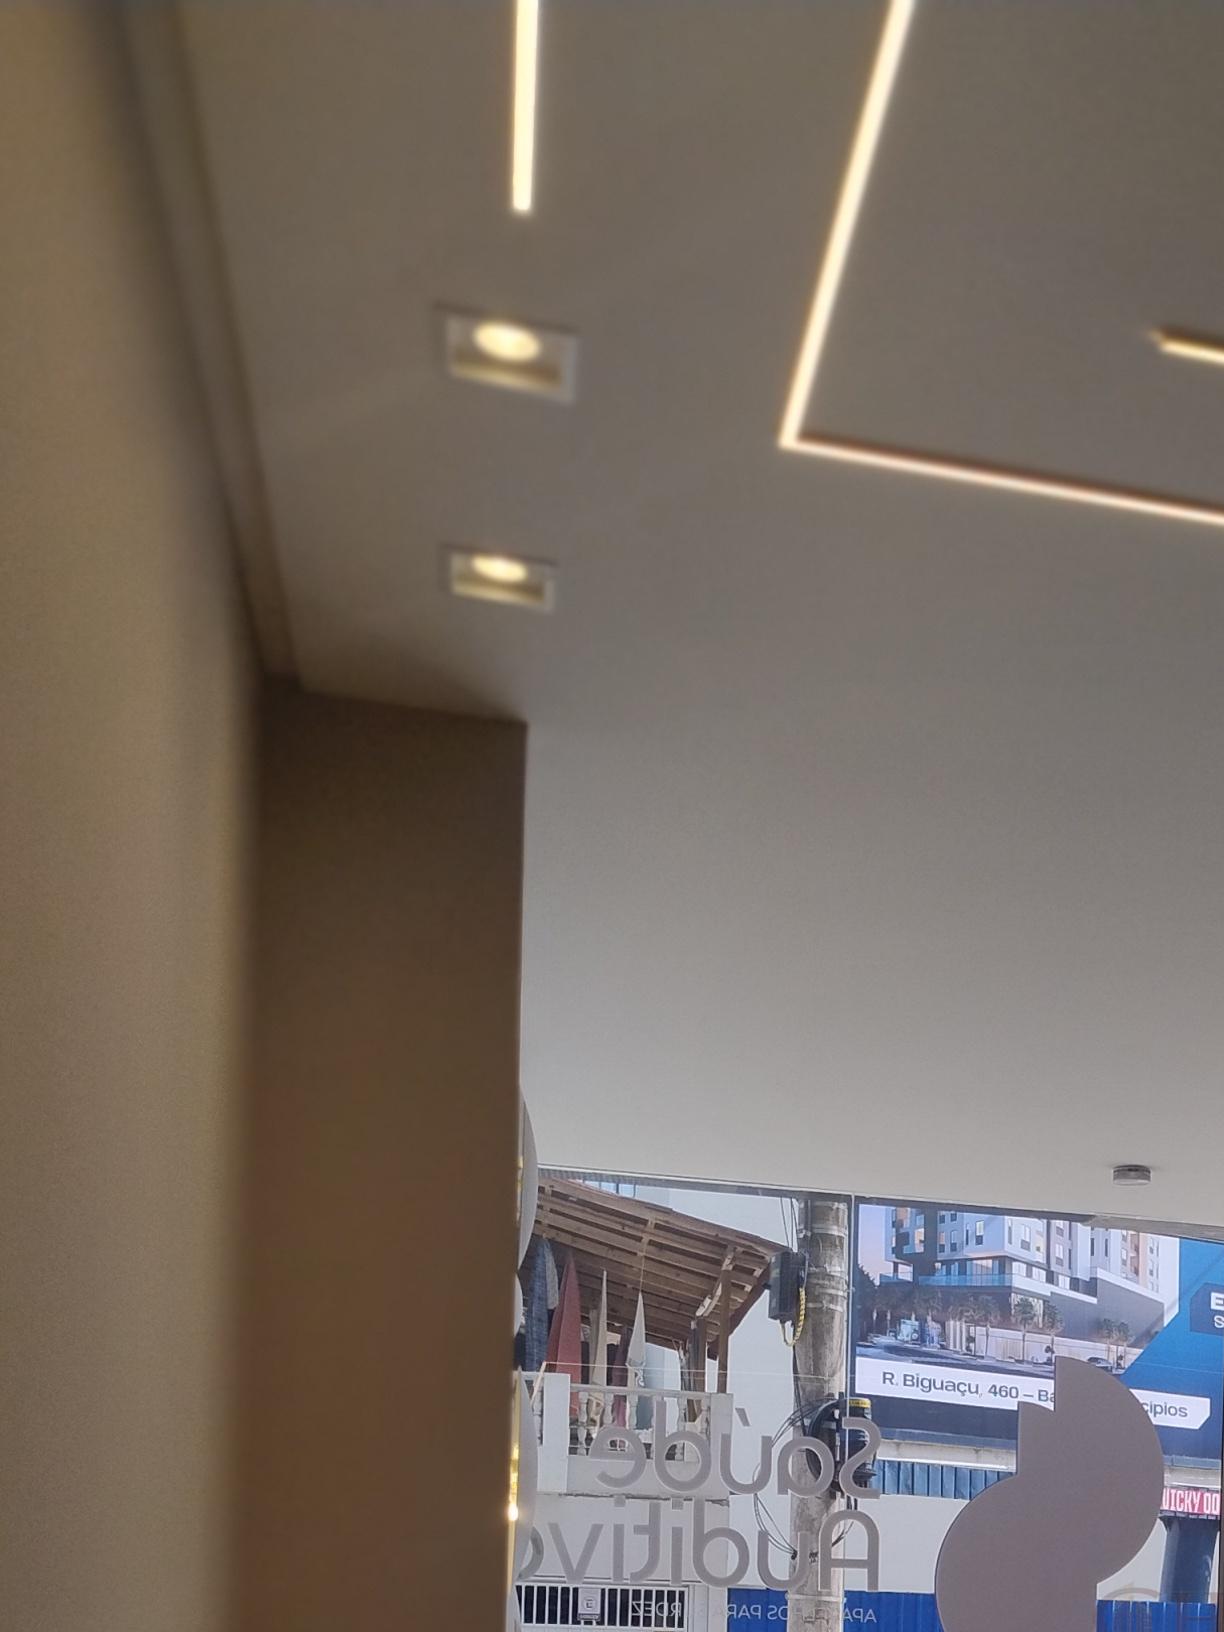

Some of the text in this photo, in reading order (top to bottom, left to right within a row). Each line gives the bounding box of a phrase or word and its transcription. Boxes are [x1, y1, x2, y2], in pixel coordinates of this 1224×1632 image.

[882, 1371, 899, 1386] R.
[902, 1372, 983, 1398] Biguaçu,
[988, 1383, 1019, 1399] 460
